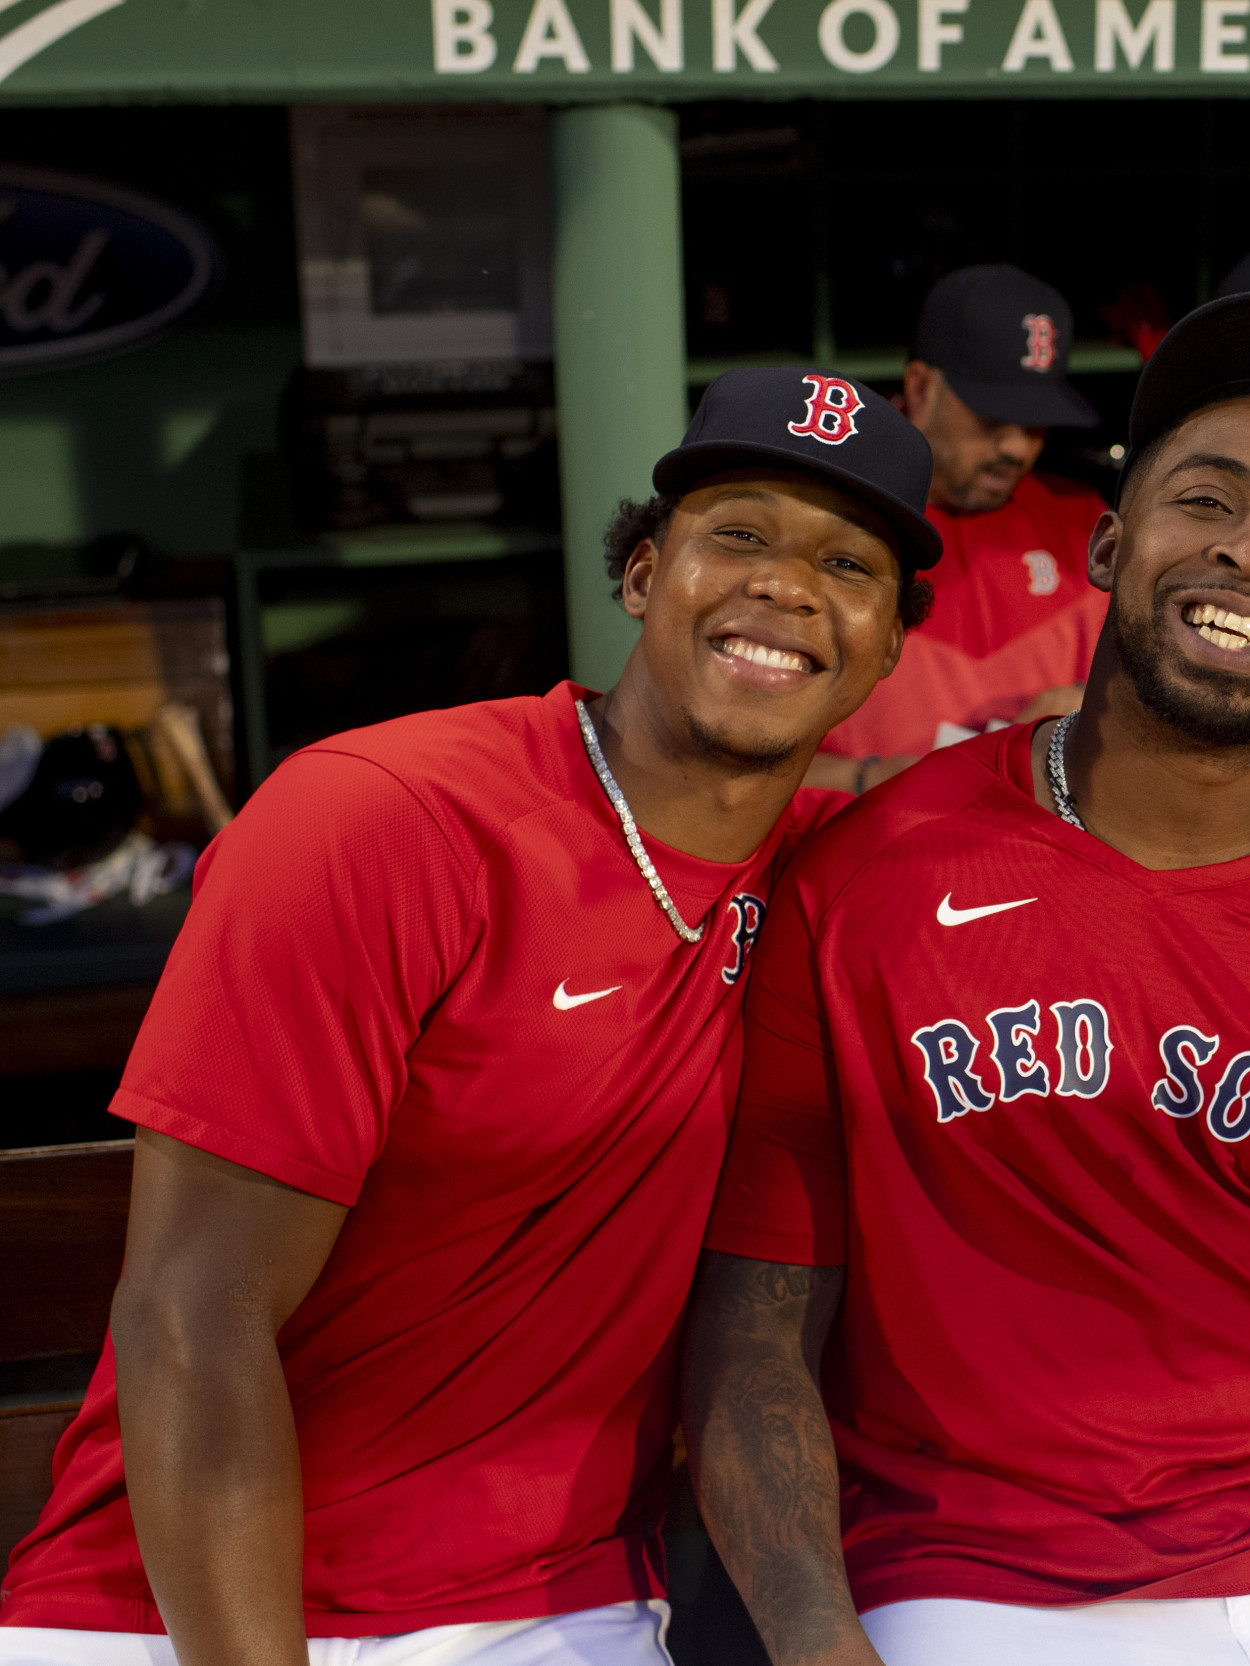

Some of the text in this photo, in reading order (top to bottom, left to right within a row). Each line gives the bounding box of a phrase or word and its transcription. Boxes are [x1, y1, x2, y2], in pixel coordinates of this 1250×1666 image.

[431, 0, 780, 74] BANK
[817, 0, 972, 74] OF
[1020, 313, 1058, 373] B
[787, 374, 866, 446] B
[1021, 549, 1061, 597] B
[911, 998, 1115, 1123] RED
